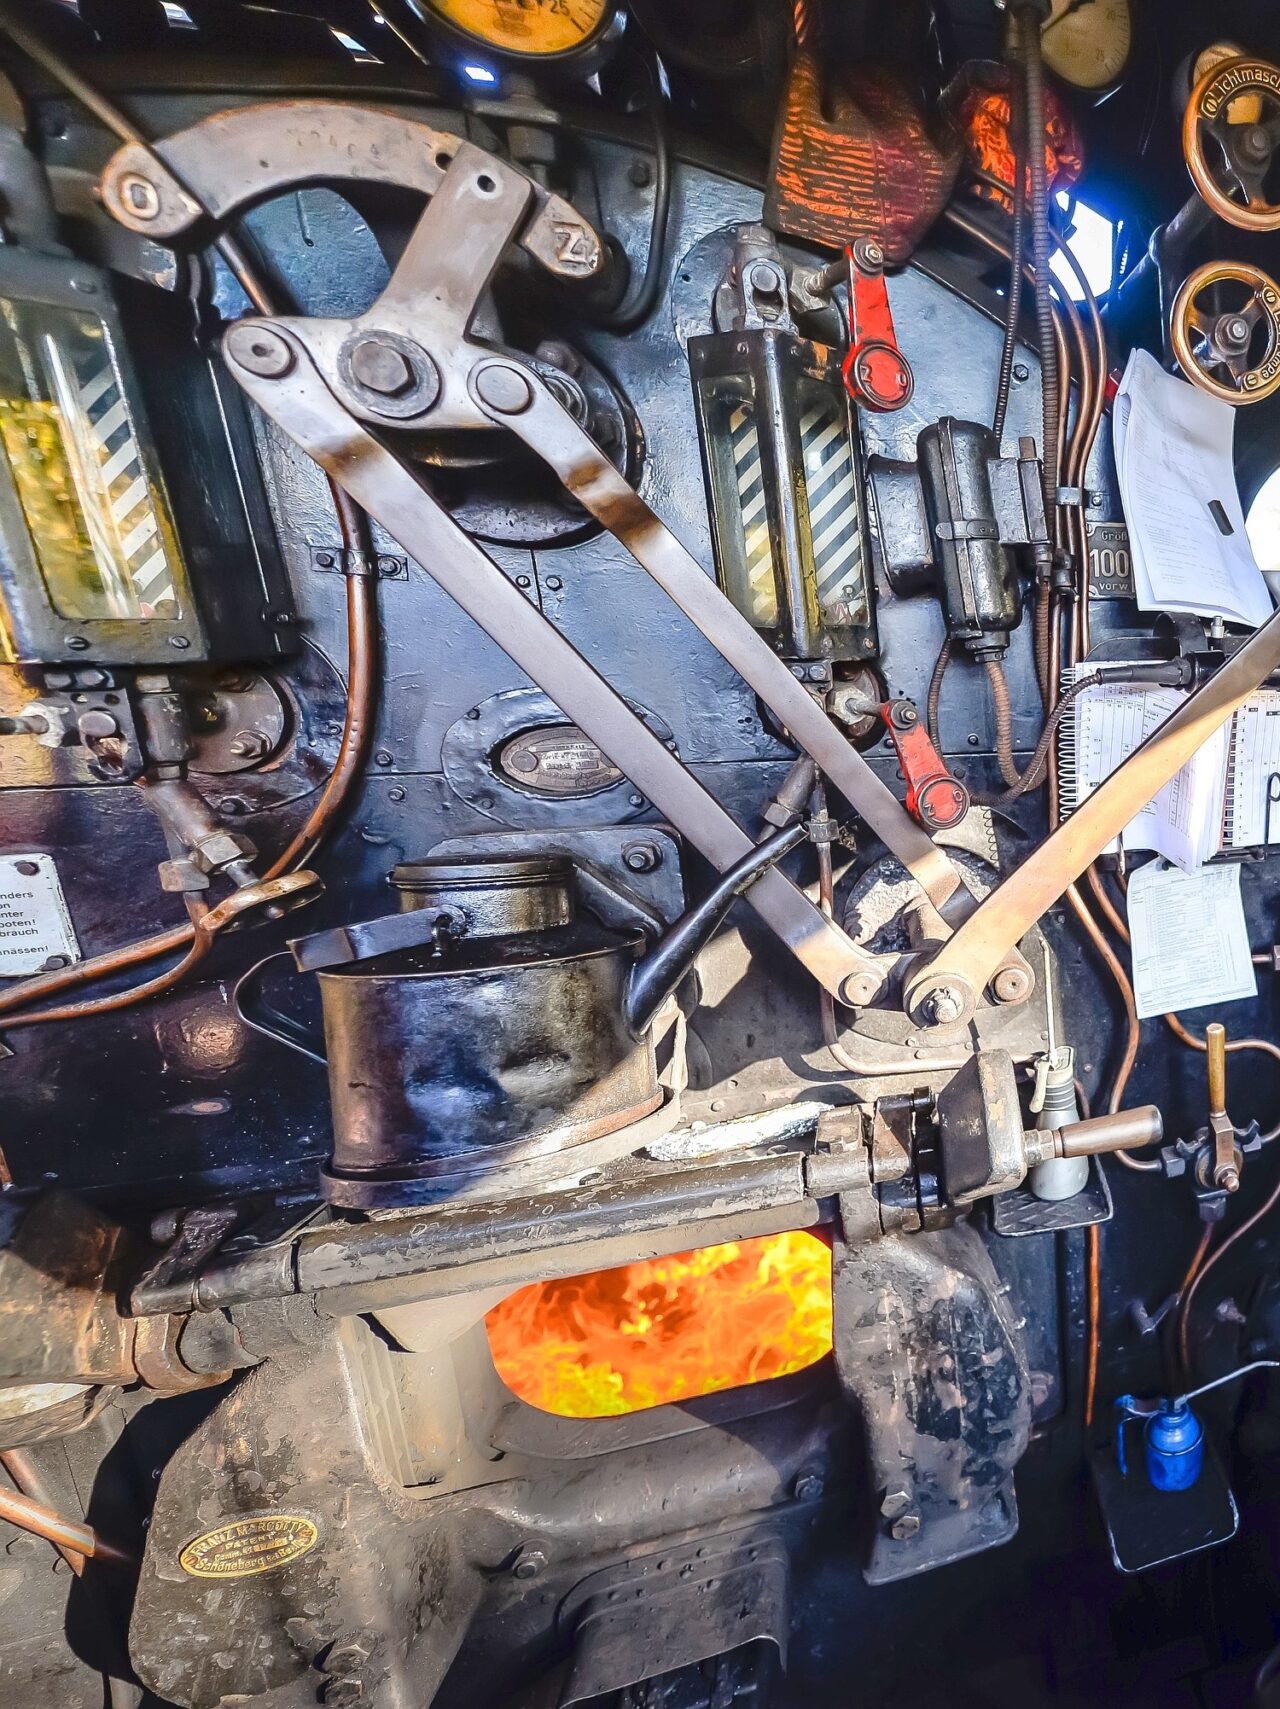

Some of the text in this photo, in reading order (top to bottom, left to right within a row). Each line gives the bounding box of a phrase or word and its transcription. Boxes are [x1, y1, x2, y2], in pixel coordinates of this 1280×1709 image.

[550, 0, 570, 16] 25
[1090, 548, 1129, 578] 100
[0, 911, 24, 919] nter
[190, 1531, 236, 1557] FRANZ
[225, 1531, 276, 1550] PATENT
[196, 1556, 265, 1572] Schöneberg
